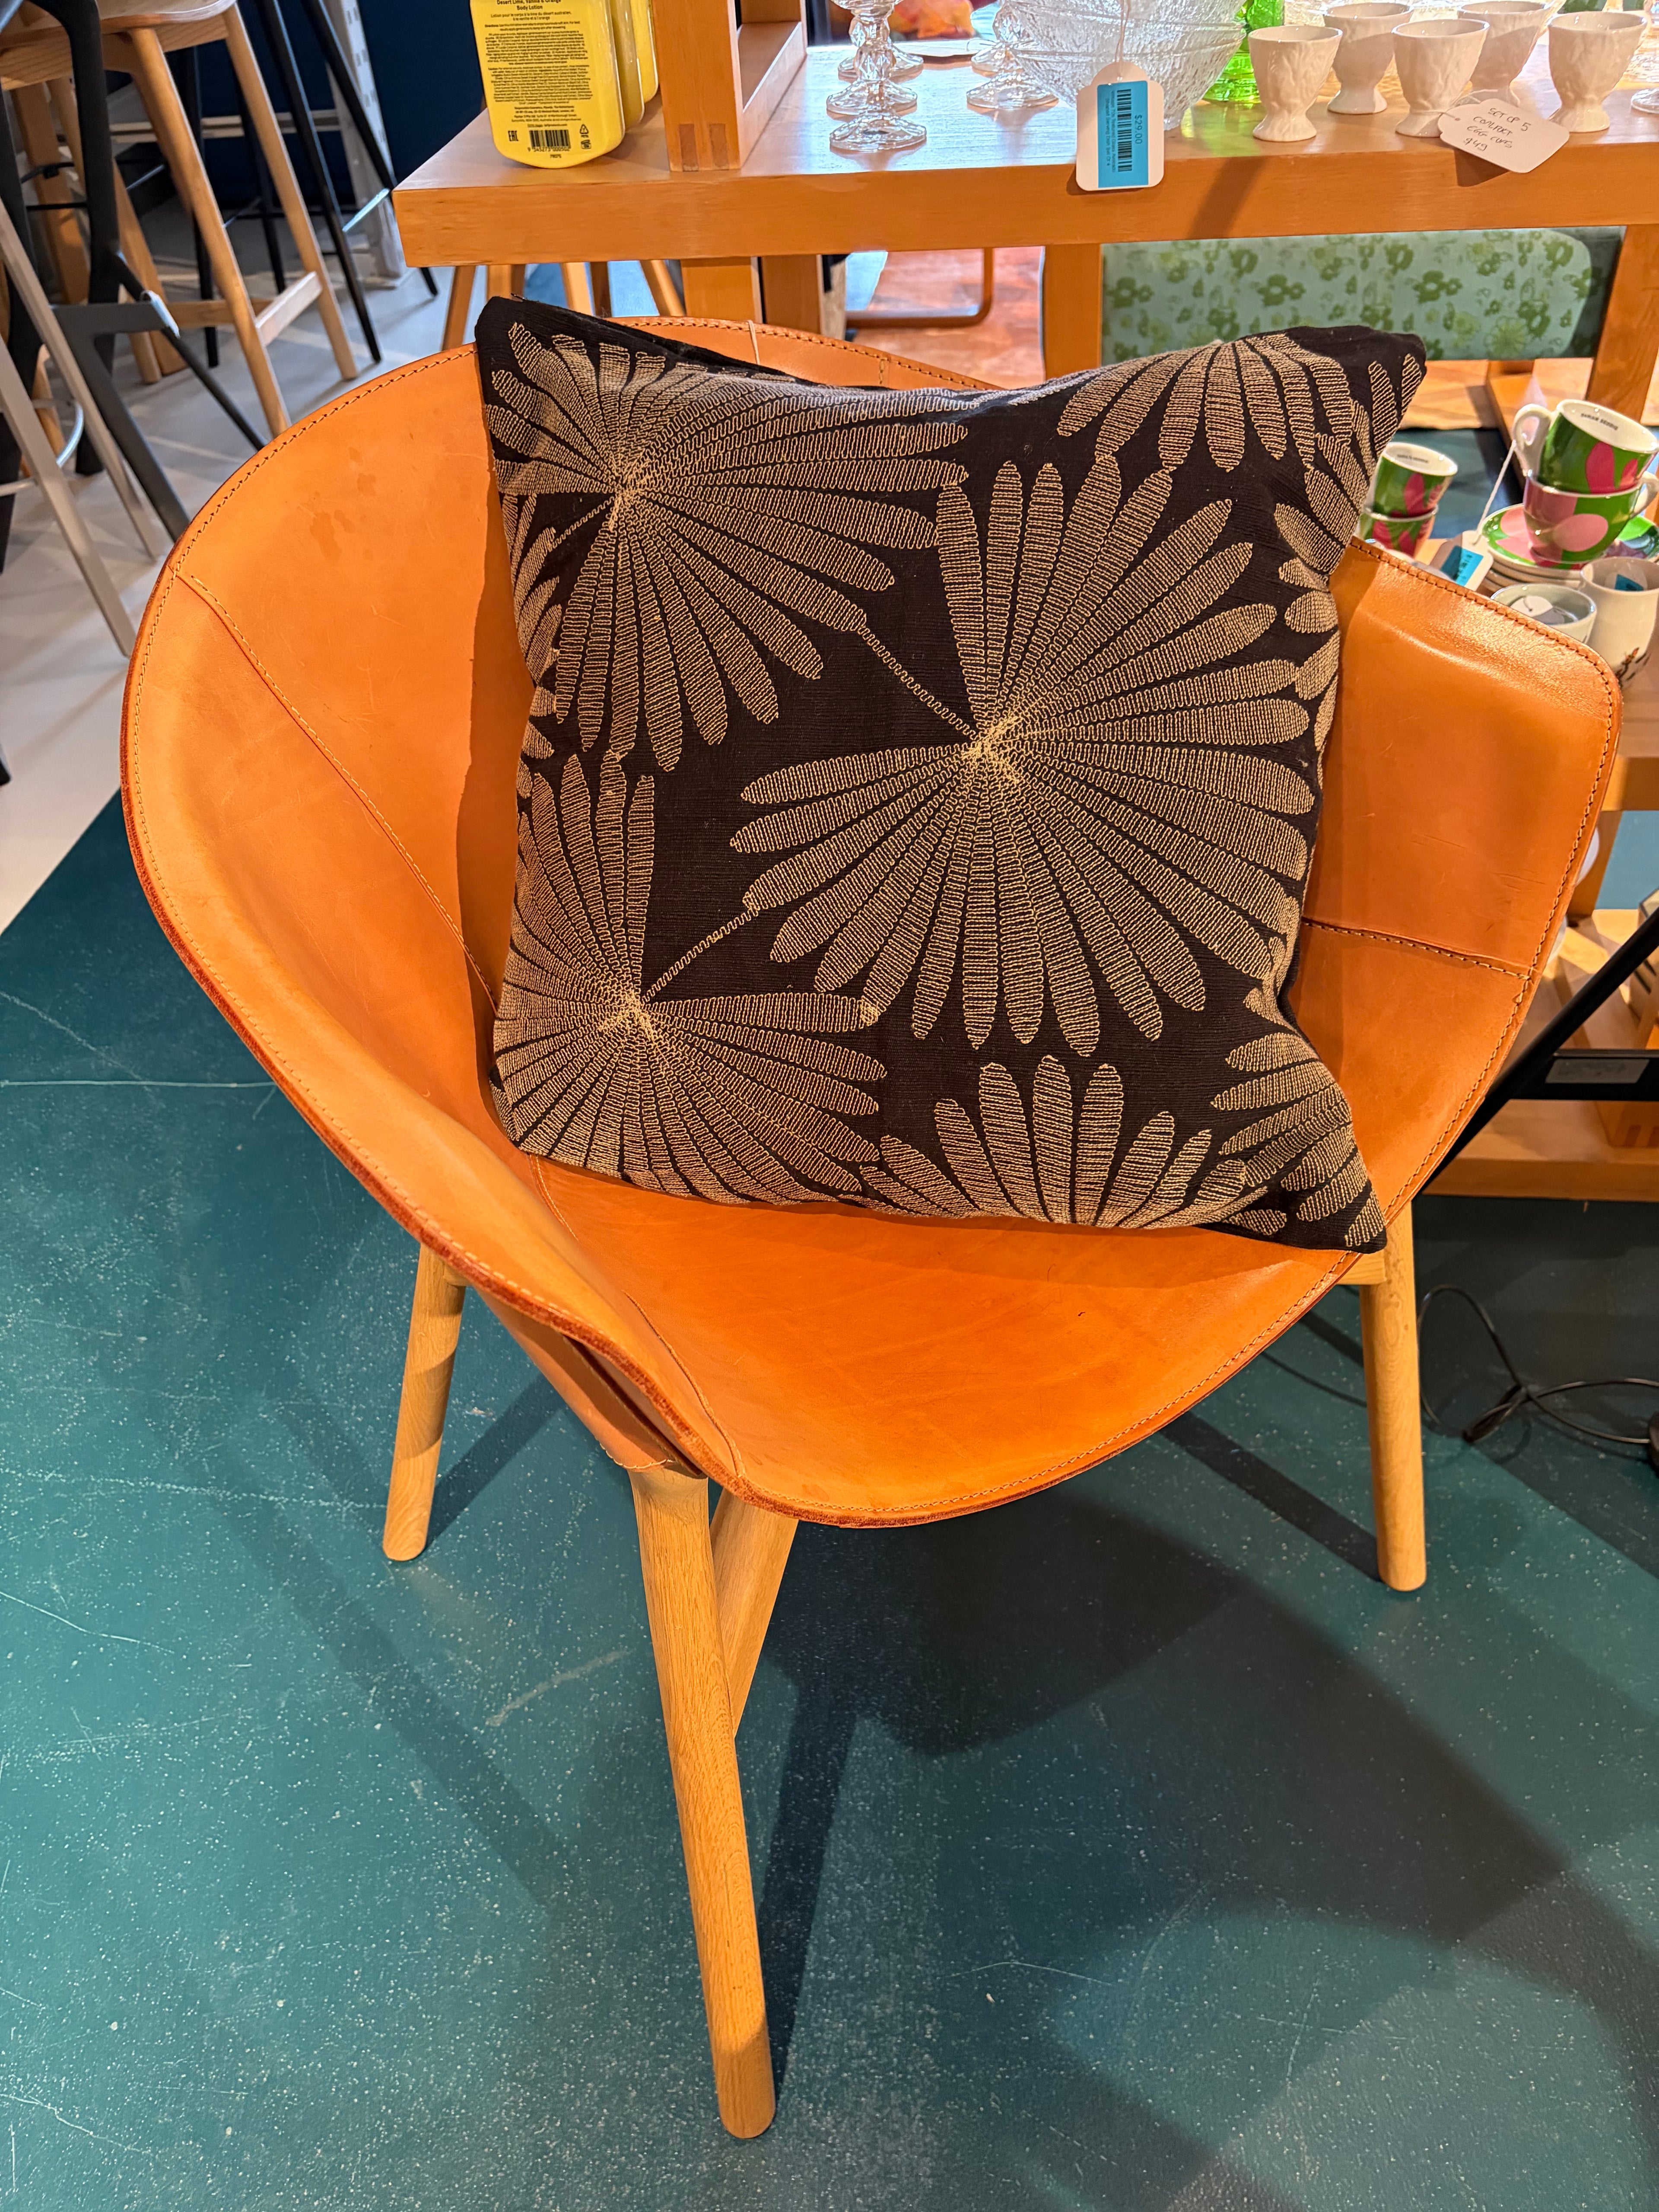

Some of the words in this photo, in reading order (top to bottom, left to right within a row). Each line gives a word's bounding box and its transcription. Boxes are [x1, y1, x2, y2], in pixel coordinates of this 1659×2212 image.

[1135, 114, 1143, 144] $29.00
[1521, 122, 1532, 131] 5
[1463, 137, 1488, 151] $49
[1467, 125, 1489, 137] EGG
[1490, 136, 1513, 148] CUPS
